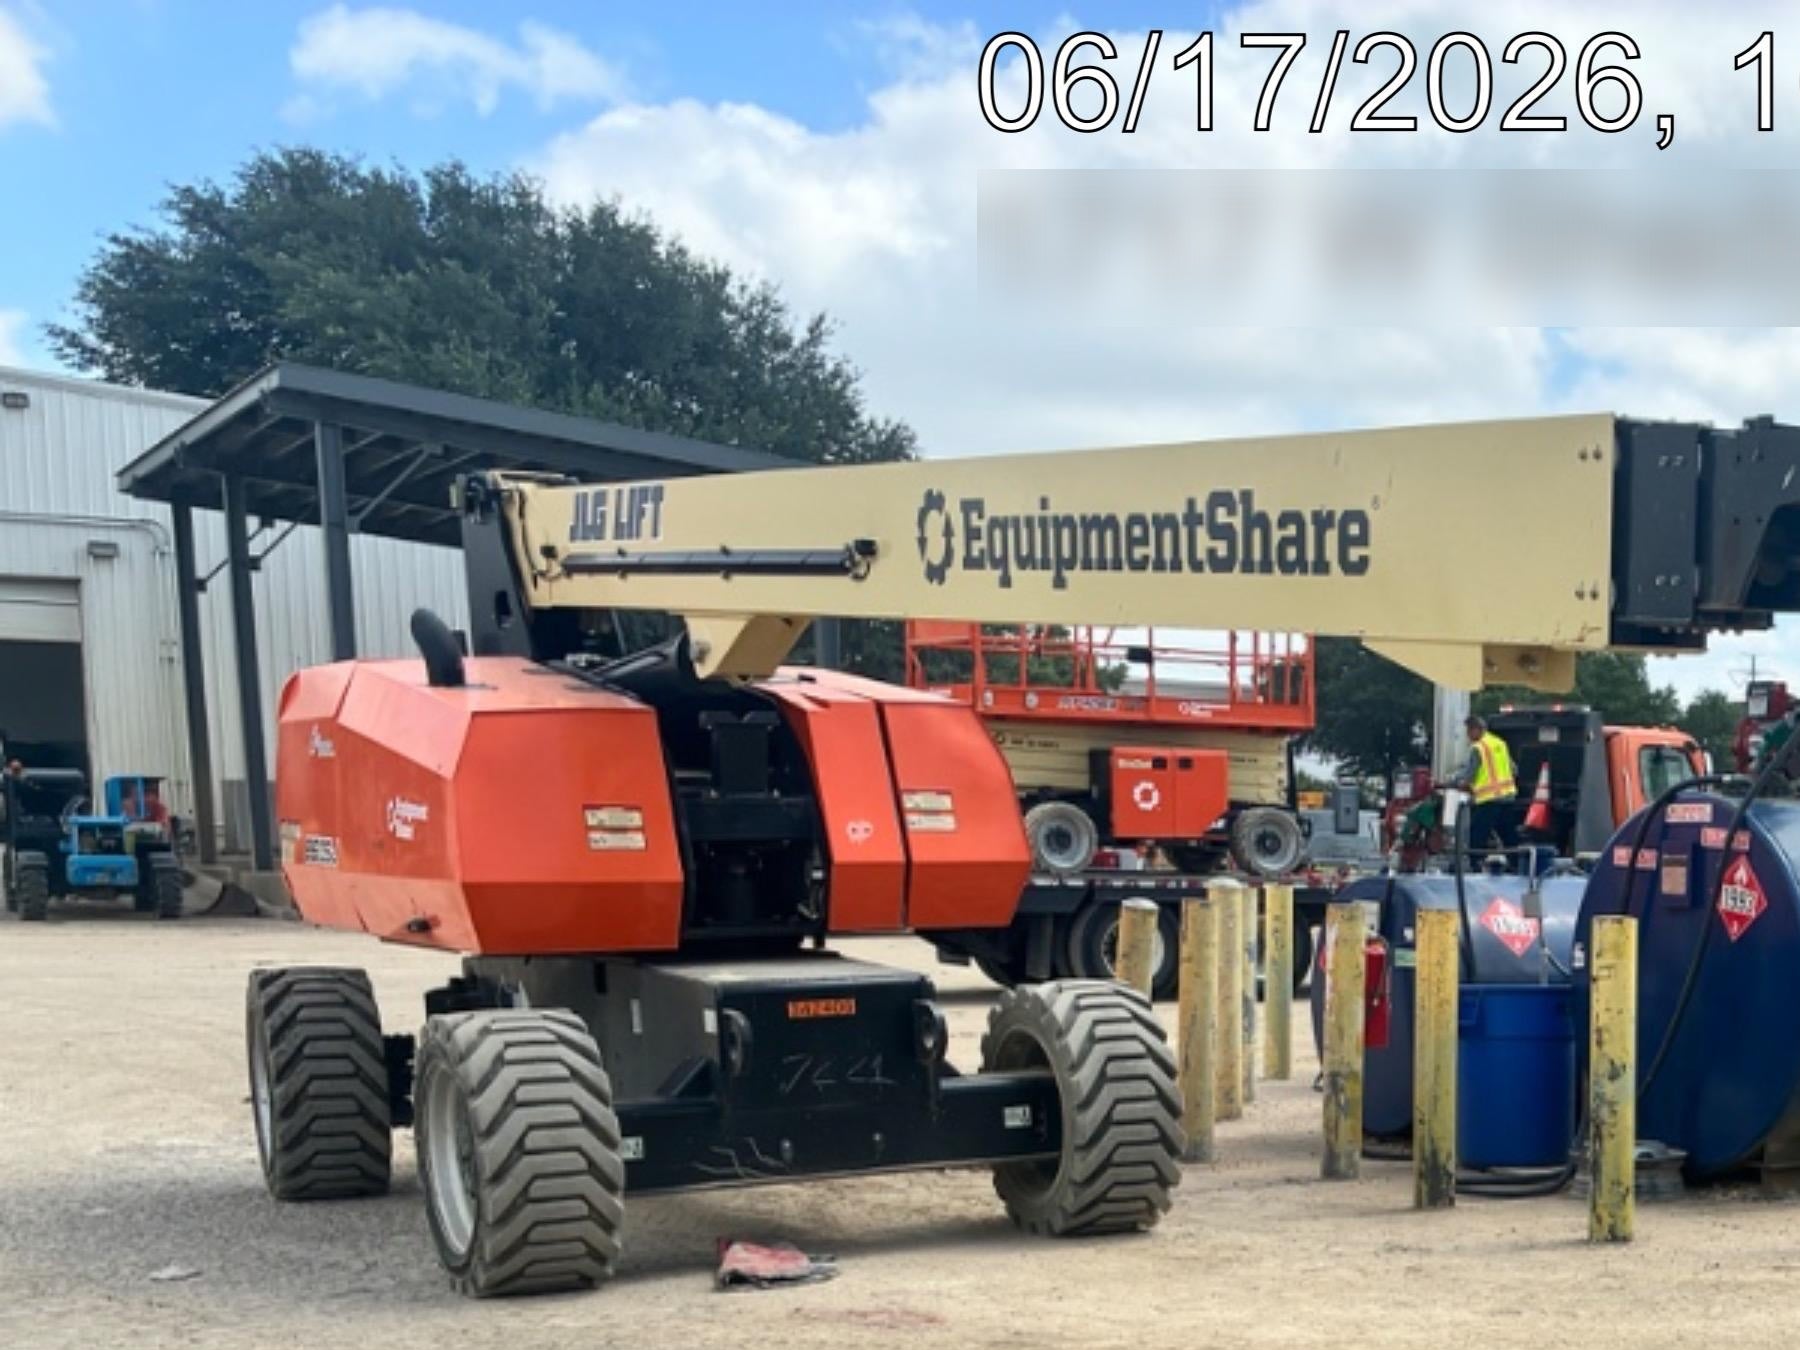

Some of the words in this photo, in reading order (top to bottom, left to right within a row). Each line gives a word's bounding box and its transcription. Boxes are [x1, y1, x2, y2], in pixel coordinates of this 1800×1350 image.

[570, 488, 607, 544] JLG
[613, 484, 665, 541] LIFT
[960, 489, 1370, 589] EquipmentShare
